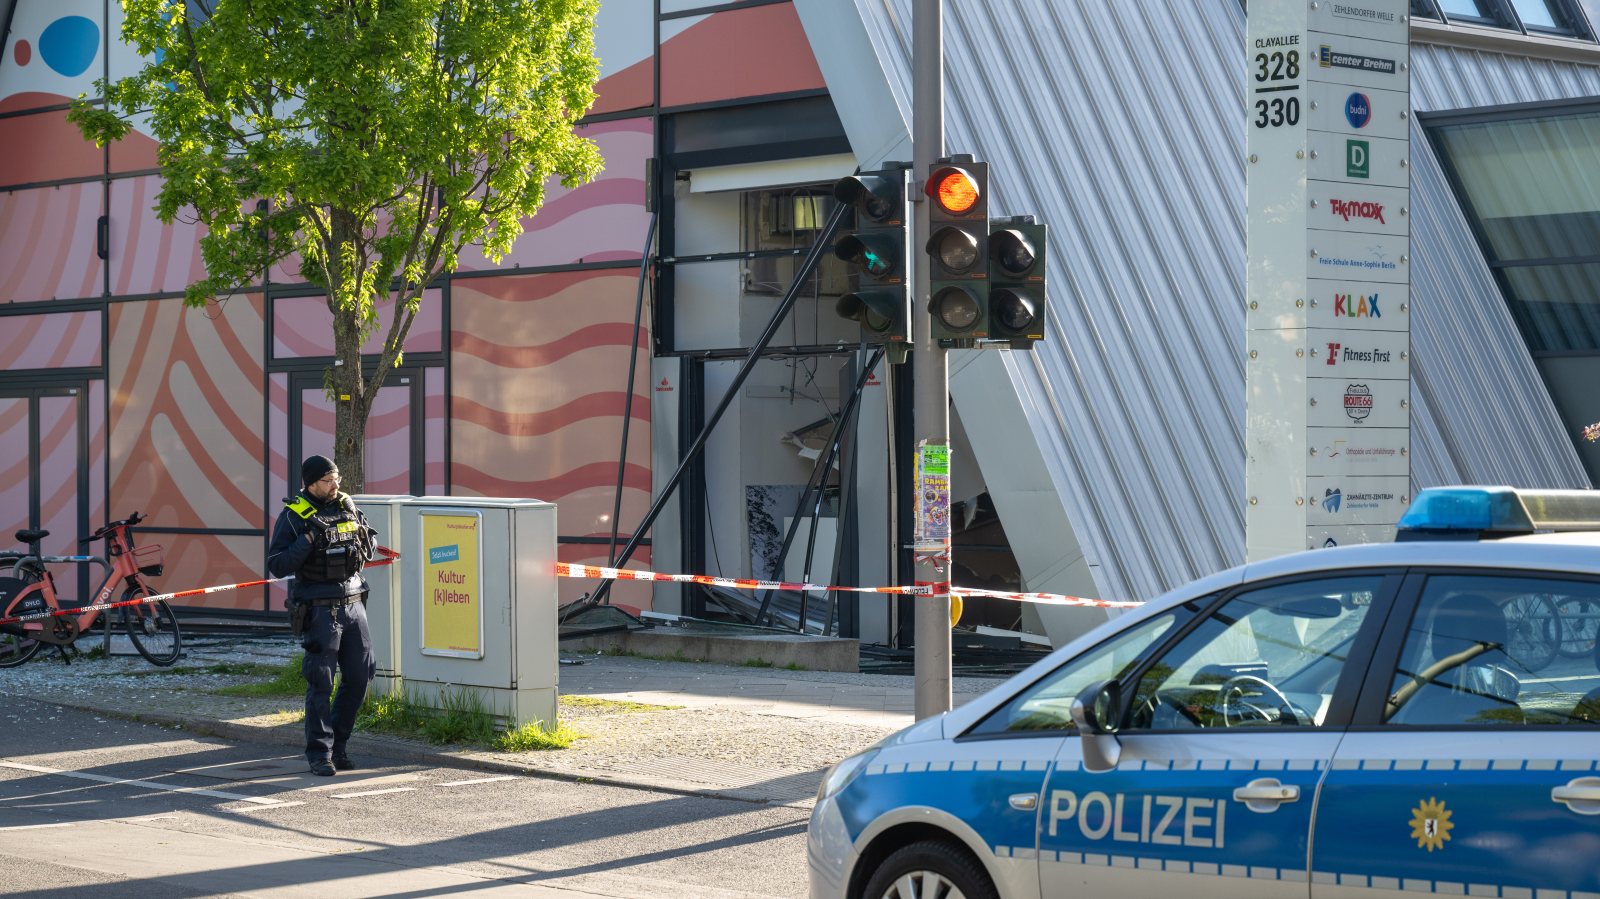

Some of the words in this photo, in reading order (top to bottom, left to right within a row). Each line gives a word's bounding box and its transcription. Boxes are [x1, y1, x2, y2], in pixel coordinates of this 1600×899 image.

[1334, 4, 1376, 19] ZEHLENDORFER
[1377, 12, 1394, 21] WELLE
[1255, 35, 1300, 48] CLAYALLEE
[1255, 50, 1300, 82] 328
[1332, 55, 1362, 66] center
[1363, 58, 1393, 71] Brehm
[1255, 96, 1300, 128] 330
[1350, 103, 1367, 116] budni
[1319, 257, 1332, 265] Freie
[1333, 258, 1349, 267] Schule
[1350, 259, 1381, 269] Anne-Sophie
[1381, 261, 1396, 269] Berlin
[1335, 293, 1381, 318] KLAX
[1343, 347, 1372, 362] Fitness
[1373, 348, 1391, 363] First
[1345, 396, 1362, 406] ROUTE
[1362, 396, 1372, 406] 66
[1346, 493, 1394, 501] ZAHNÄRZTE-ZENTRUM
[438, 569, 466, 584] Kultur
[433, 588, 470, 606] (k)leben
[1048, 789, 1227, 849] POLIZEI
